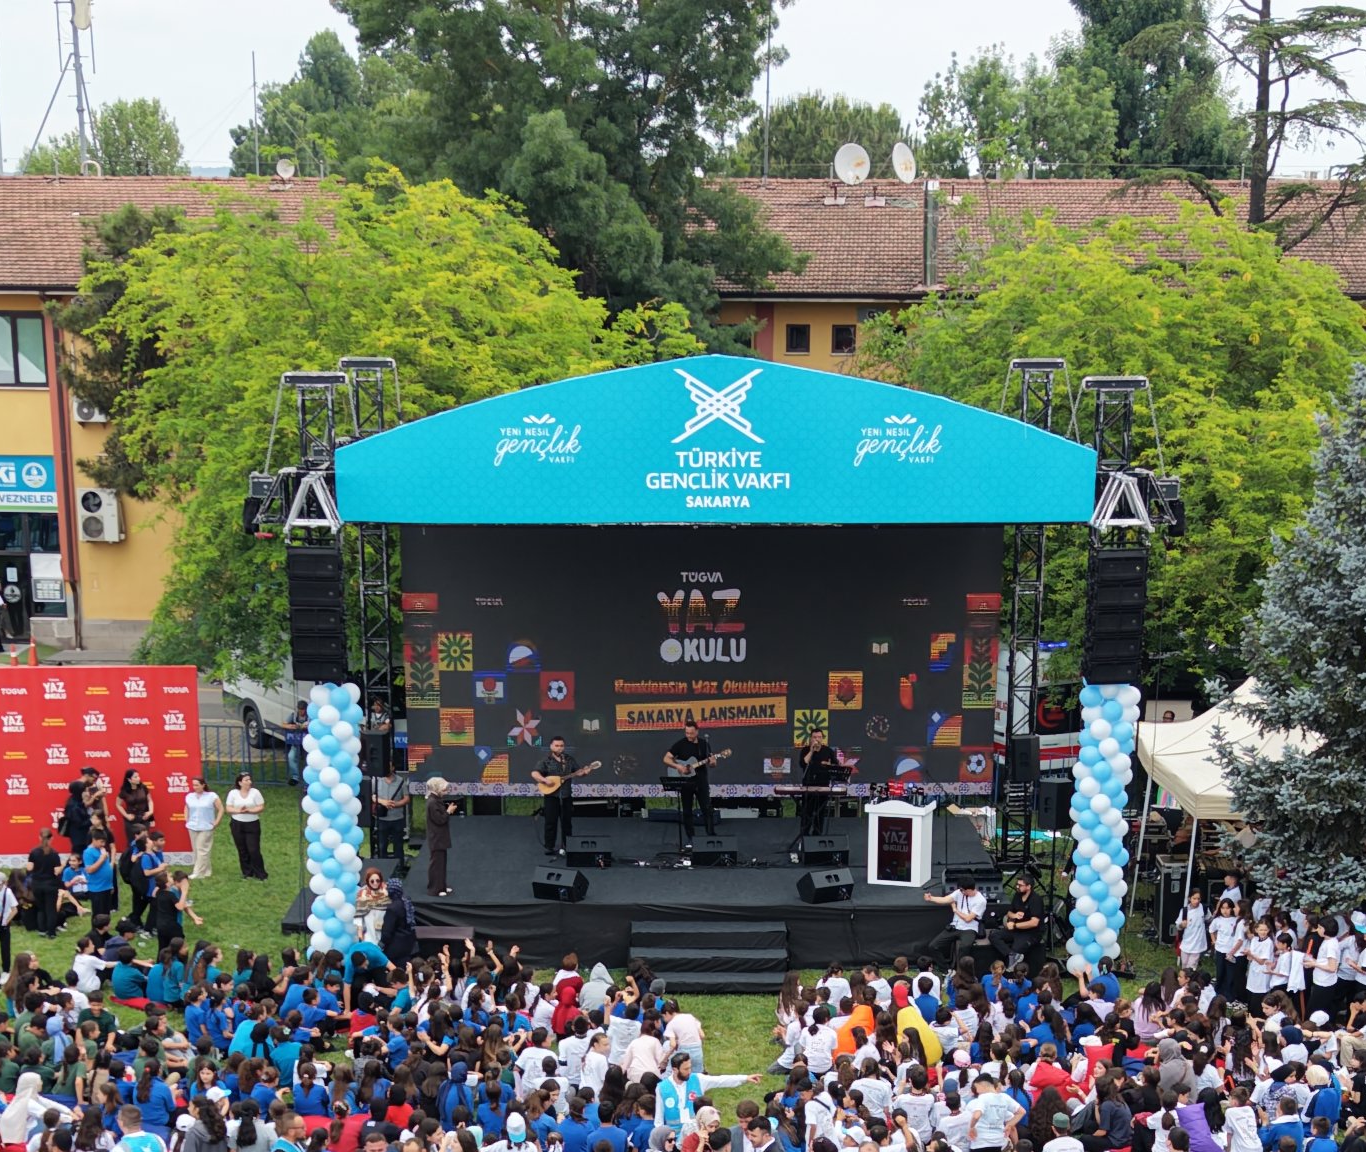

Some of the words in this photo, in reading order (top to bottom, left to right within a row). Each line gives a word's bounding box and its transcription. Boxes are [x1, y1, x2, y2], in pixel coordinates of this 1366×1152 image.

[493, 424, 582, 467] gençlik
[854, 425, 942, 467] gençlik
[675, 448, 761, 468] TÜRKİYE
[645, 469, 729, 490] GENÇLİK
[732, 473, 790, 489] VAKFI
[0, 495, 53, 503] VEZNELER
[686, 495, 750, 508] SAKARYA
[681, 572, 723, 583] TÜGVA
[657, 588, 745, 633] YAZ
[660, 637, 747, 663] OKULU
[43, 682, 65, 693] YAZ
[123, 681, 146, 692] YAZ
[615, 679, 687, 694] Renklensin
[692, 680, 718, 694] Yaz
[723, 680, 788, 694] Okulumuz
[83, 714, 105, 725] YAZ
[163, 714, 185, 724] YAZ
[627, 708, 695, 724] SAKARYA
[701, 704, 776, 721] LANSMANI
[1, 715, 24, 726] YAZ
[46, 748, 68, 758] YAZ
[127, 747, 149, 758] YAZ
[5, 778, 27, 789] YAZ
[166, 776, 187, 787] YAZ
[882, 831, 907, 843] YAZ
